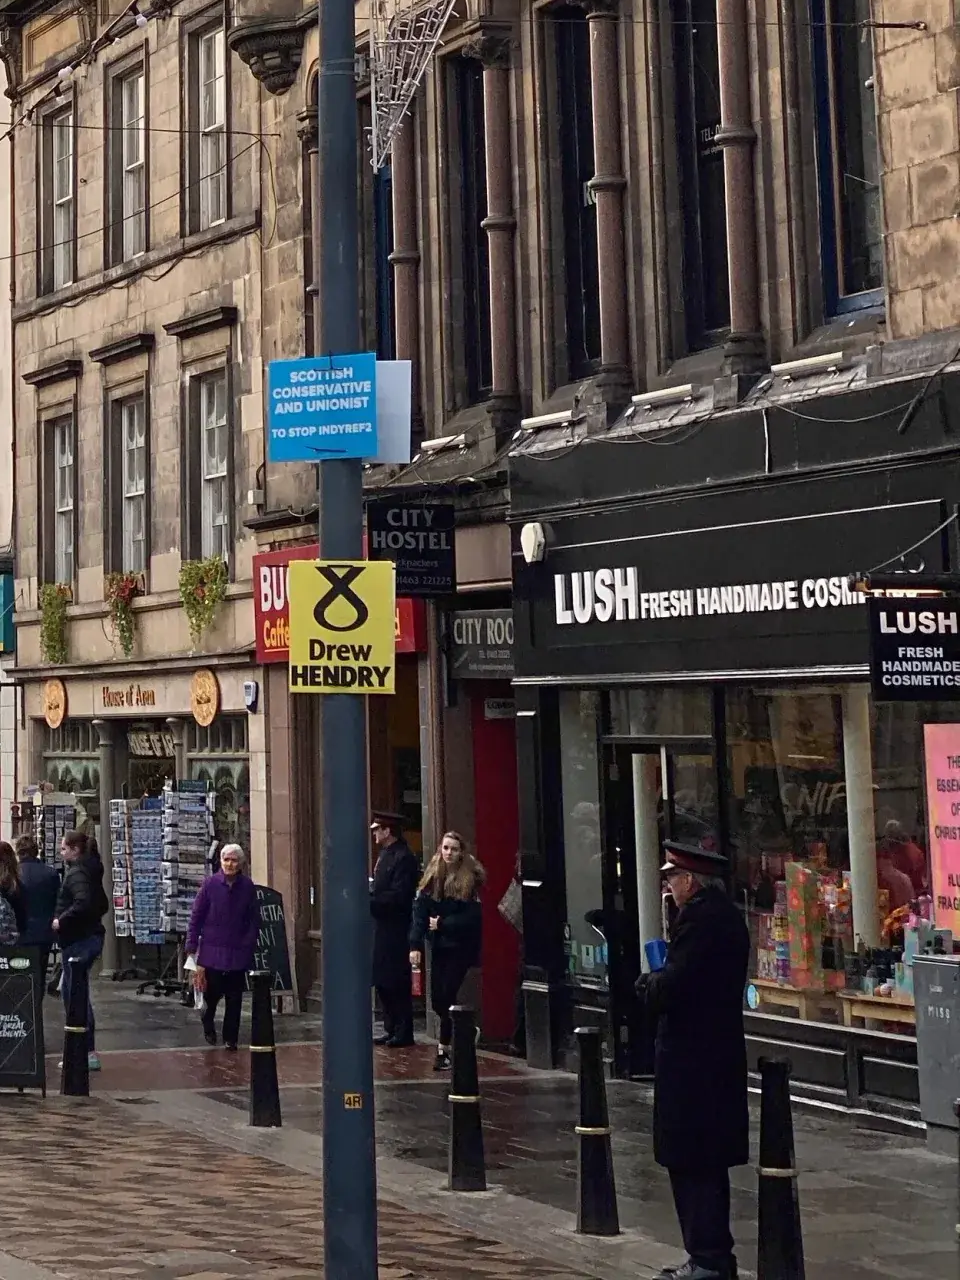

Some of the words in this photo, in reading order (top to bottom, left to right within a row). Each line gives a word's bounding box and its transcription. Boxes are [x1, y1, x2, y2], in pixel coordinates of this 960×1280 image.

[289, 367, 353, 383] SCOTTISH
[272, 381, 371, 399] CONSERVATIVE
[274, 402, 303, 415] AND
[306, 397, 369, 412] UNIONIST
[272, 429, 286, 438] TO
[288, 426, 317, 438] STOP
[319, 422, 372, 435] INDYREF2
[386, 509, 434, 527] CITY
[372, 531, 451, 550] HOSTEL
[397, 559, 439, 569] kpackers
[260, 566, 290, 612] BU
[554, 567, 639, 625] LUSH
[640, 589, 694, 619] FRESH
[696, 580, 799, 615] HANDMADE
[453, 618, 482, 644] CITY
[486, 618, 514, 645] ROO
[879, 612, 958, 634] LUSH
[309, 639, 372, 661] Drew
[898, 647, 943, 658] FRESH
[882, 661, 960, 672] HANDMADE
[291, 665, 391, 687] HENDRY
[882, 674, 960, 686] COSMETICS
[103, 686, 124, 707] House
[126, 686, 134, 706] of
[345, 1095, 361, 1107] 4R
